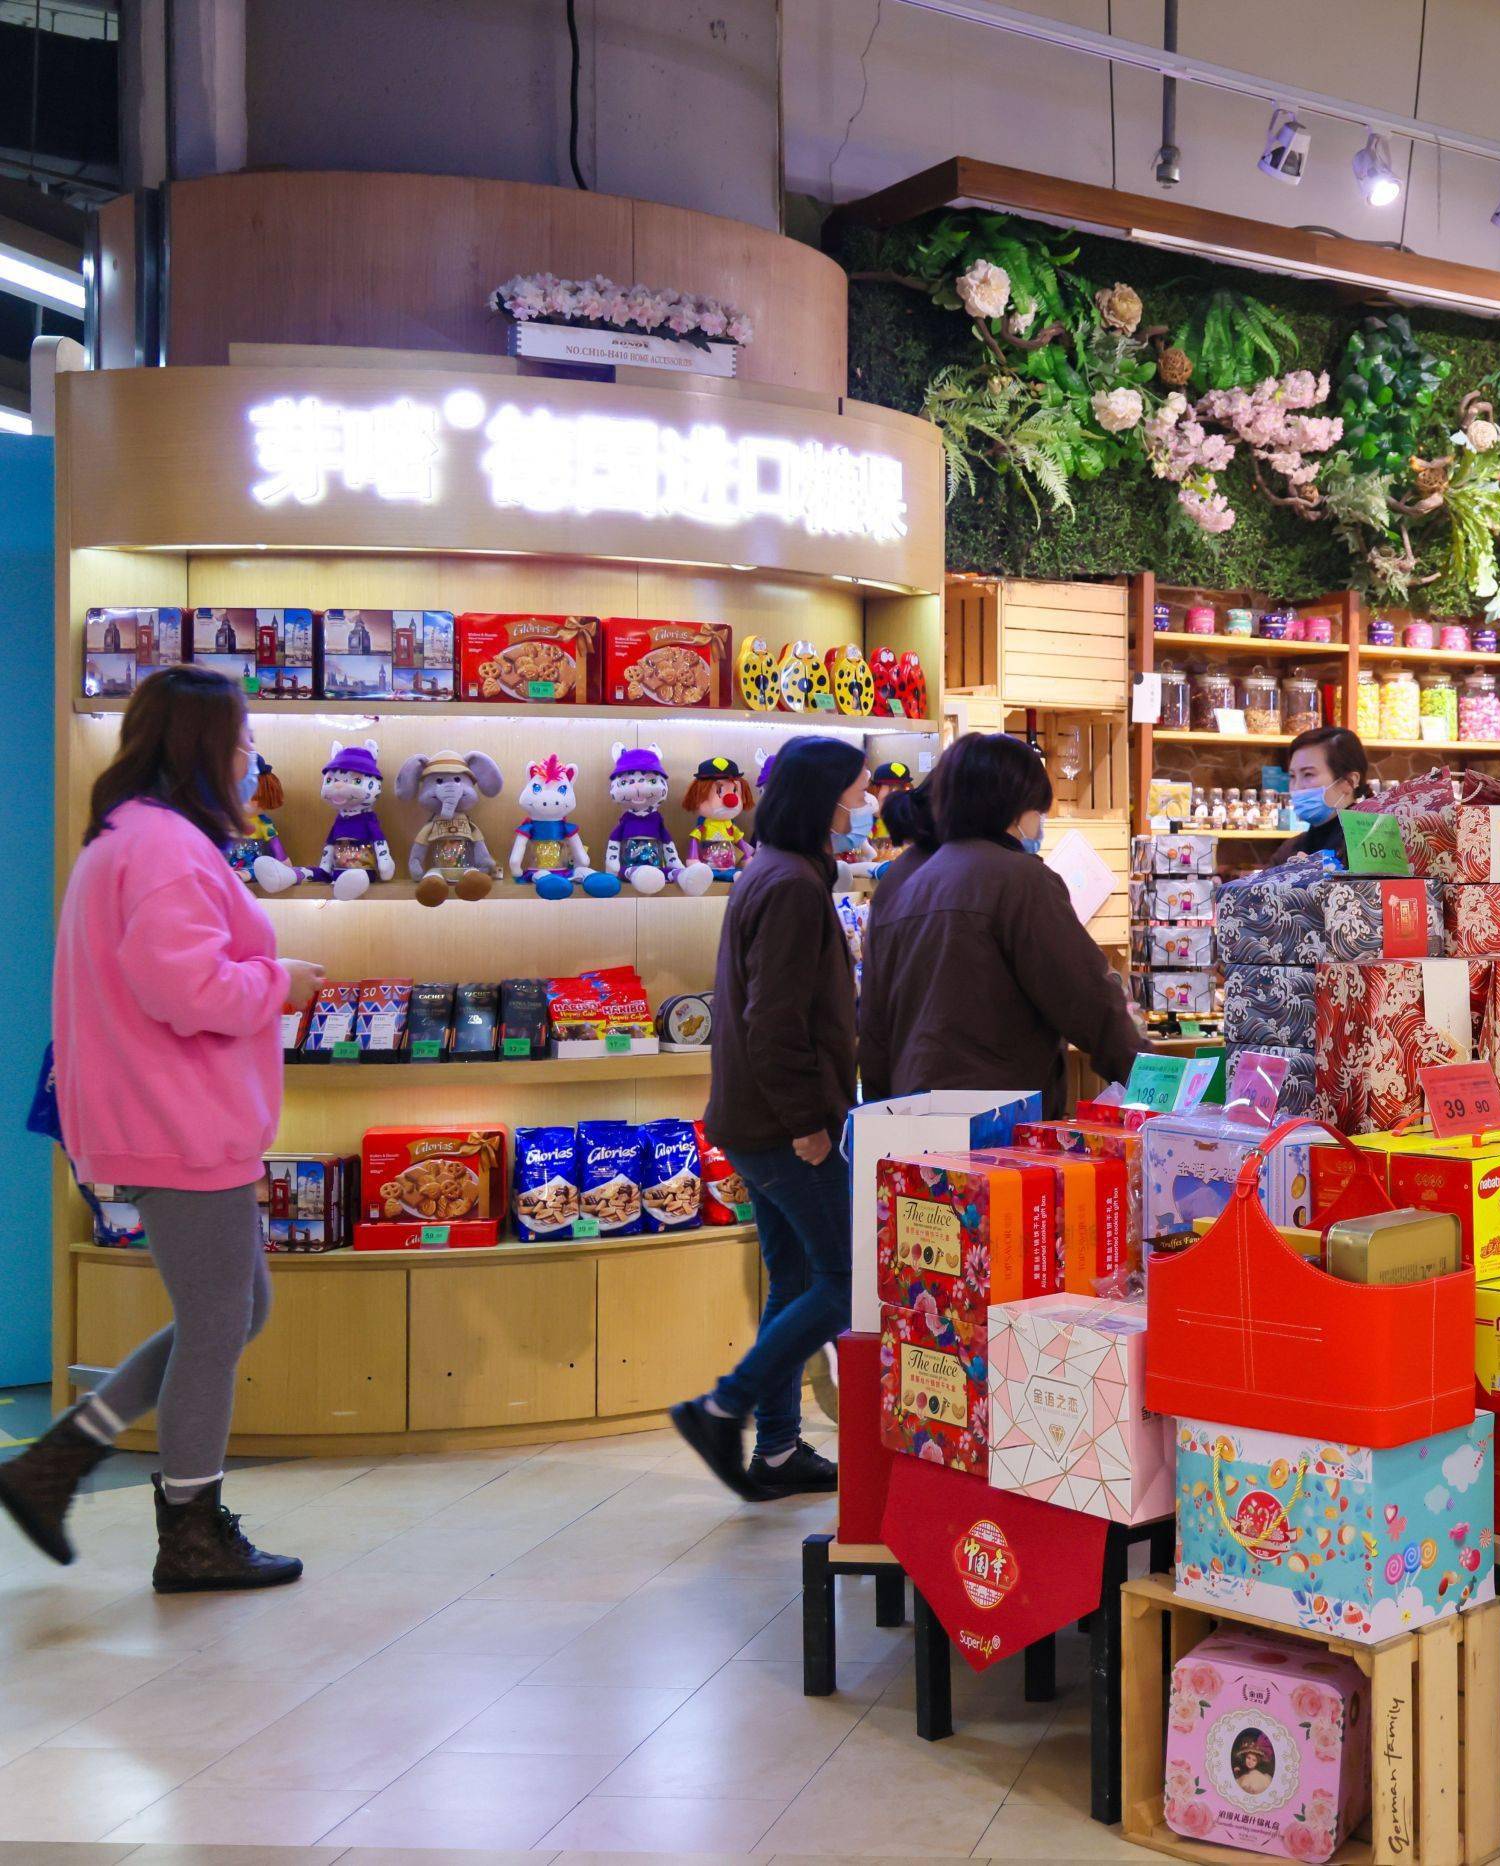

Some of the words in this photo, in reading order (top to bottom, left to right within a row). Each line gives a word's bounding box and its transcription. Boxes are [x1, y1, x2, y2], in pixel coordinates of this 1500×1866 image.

[602, 1003, 646, 1015] HARIBO
[903, 1201, 924, 1223] The
[926, 1205, 952, 1227] alice
[908, 1349, 928, 1372] The
[932, 1355, 958, 1378] alice
[963, 1537, 1007, 1587] 中国年
[1387, 1769, 1410, 1855] German
